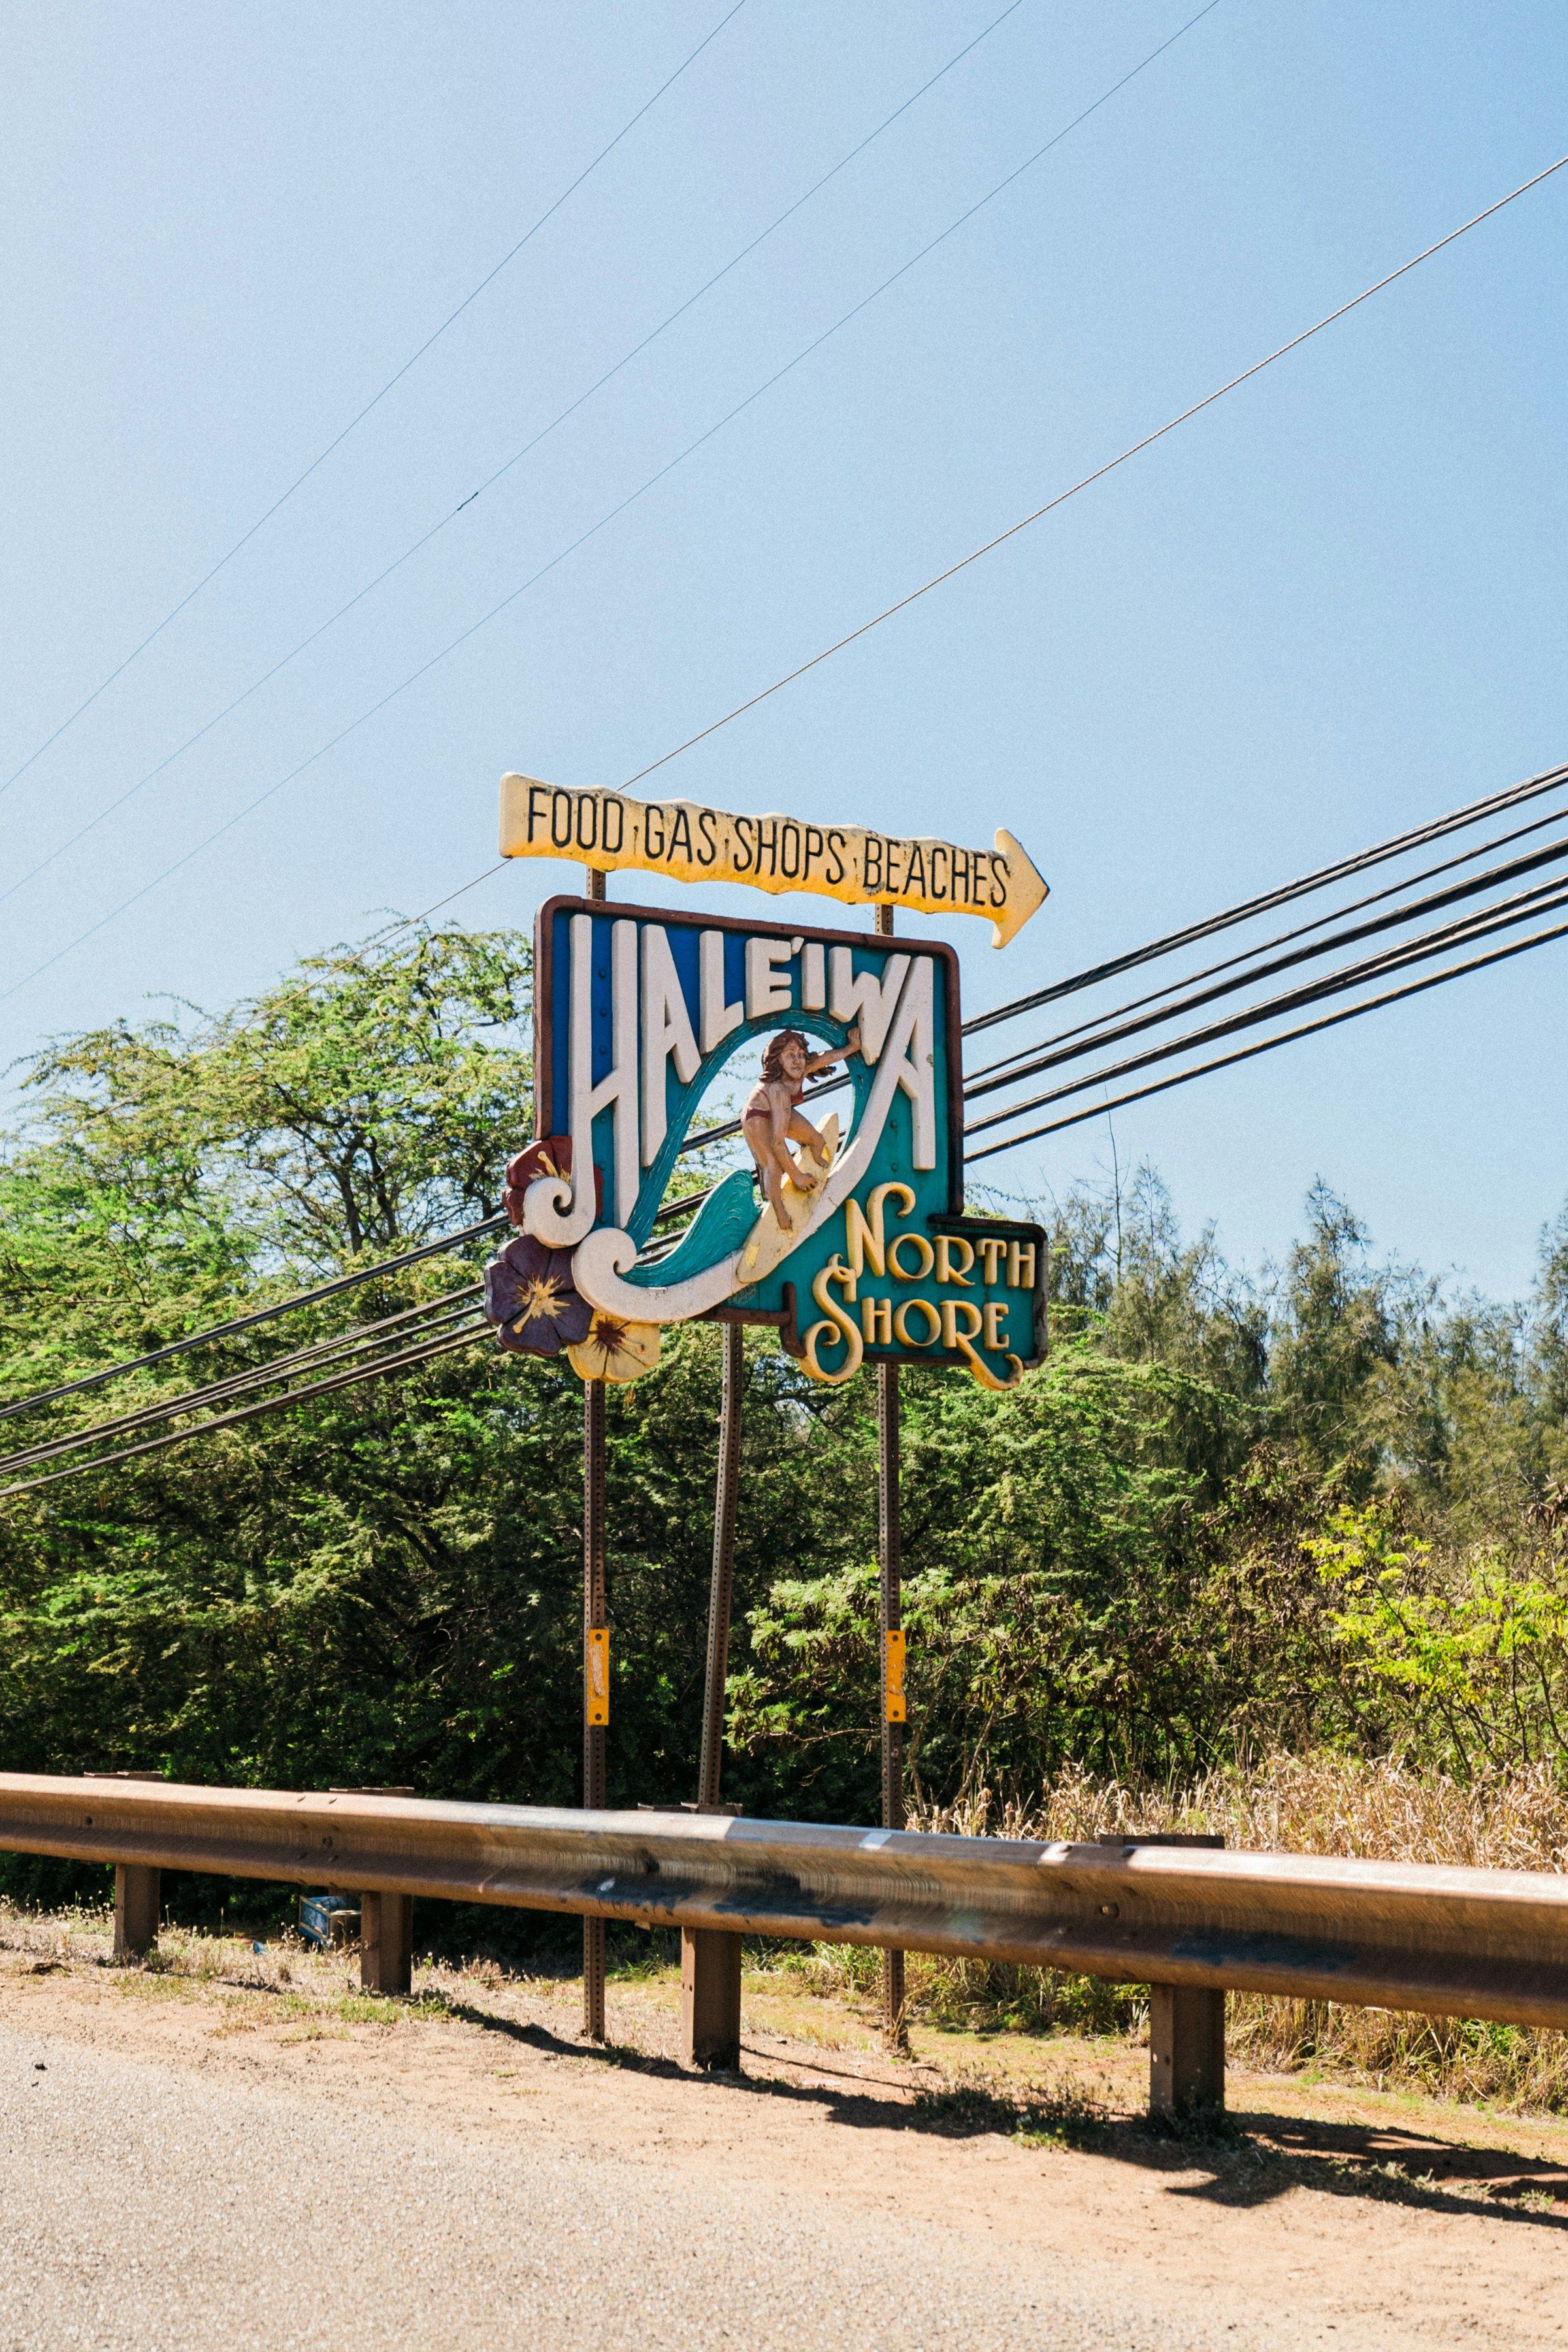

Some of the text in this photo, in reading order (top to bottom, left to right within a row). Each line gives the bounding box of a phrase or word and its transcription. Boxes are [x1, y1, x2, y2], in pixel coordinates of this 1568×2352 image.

[644, 804, 716, 866] GAS
[734, 817, 847, 885] SHOPS
[863, 837, 1011, 907] BEACHES
[845, 1181, 1036, 1288] NORTH
[796, 1253, 1024, 1391] SHORE
